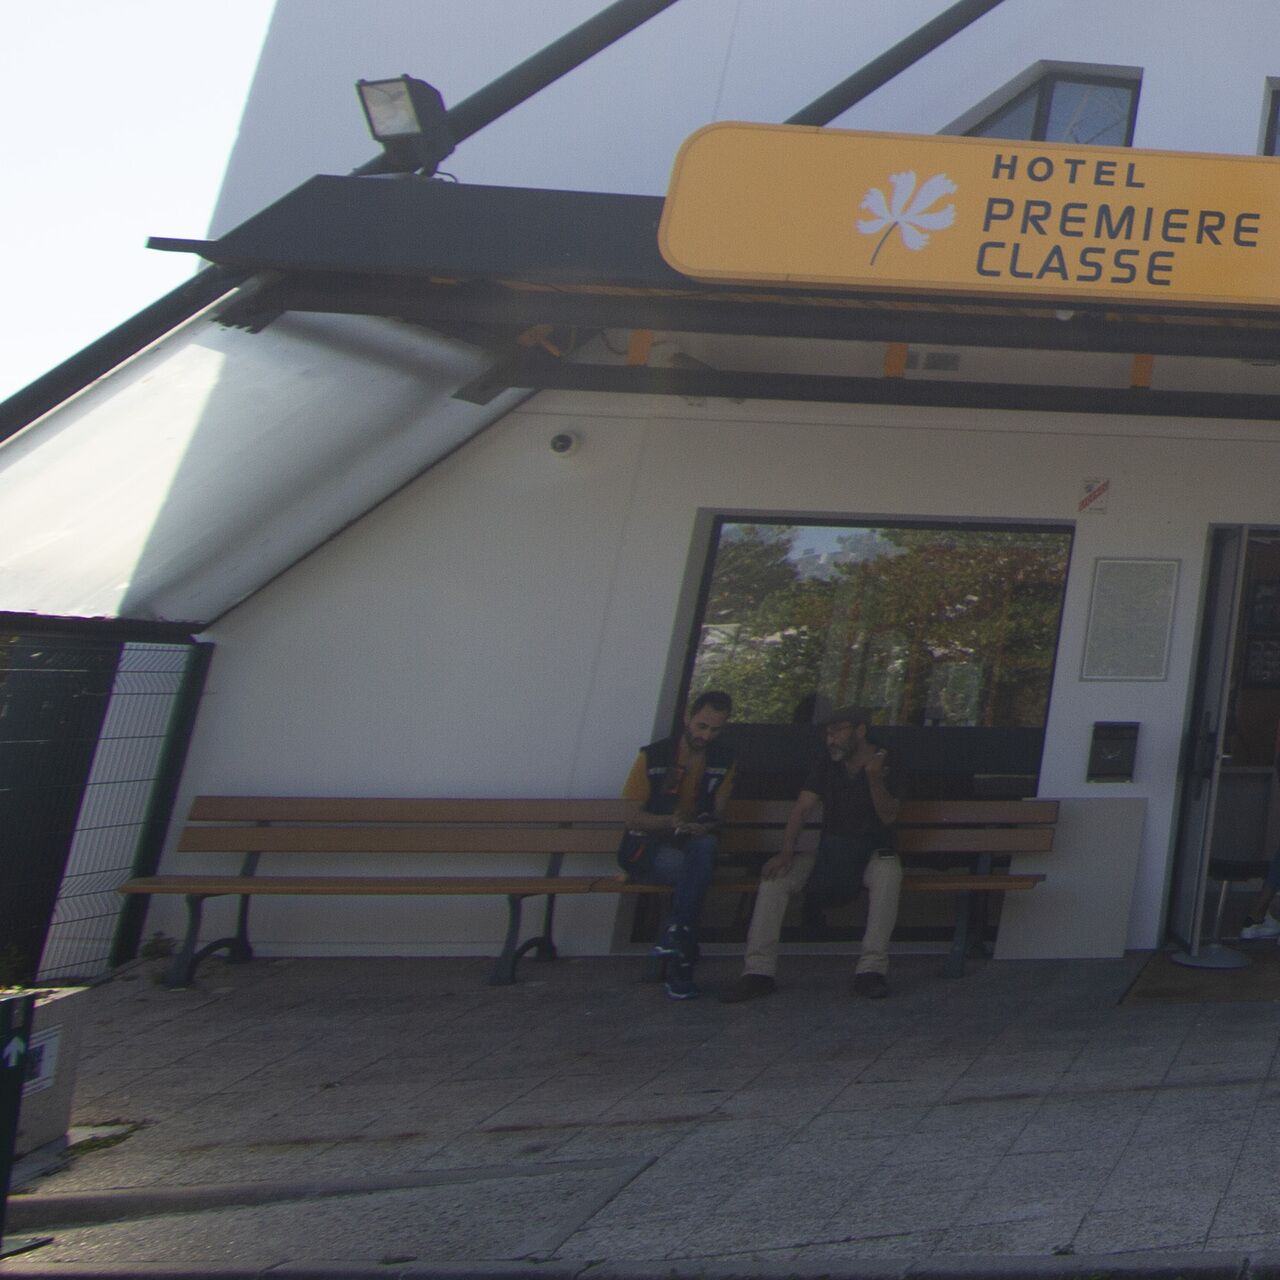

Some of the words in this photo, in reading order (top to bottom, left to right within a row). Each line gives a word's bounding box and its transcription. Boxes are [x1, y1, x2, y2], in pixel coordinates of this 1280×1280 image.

[991, 154, 1147, 189] HOTEL
[983, 197, 1262, 248] PREMIERE
[975, 241, 1176, 287] CLASSE
